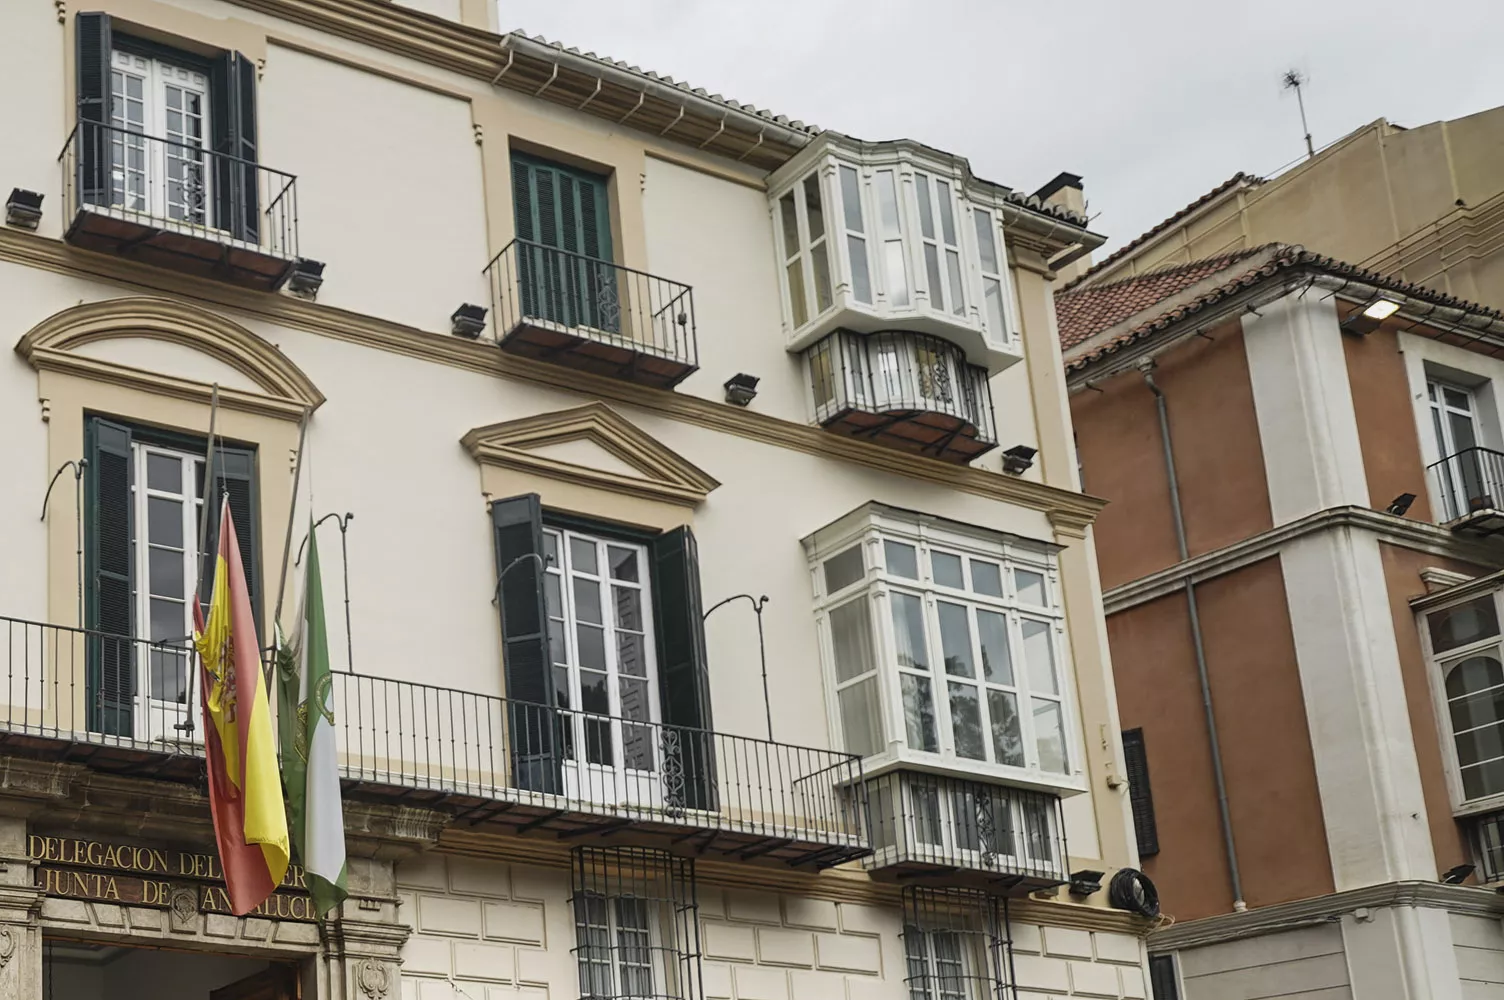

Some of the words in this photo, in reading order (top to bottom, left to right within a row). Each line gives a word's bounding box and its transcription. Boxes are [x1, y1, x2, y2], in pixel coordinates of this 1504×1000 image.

[29, 834, 167, 873] DELEGACION
[180, 852, 221, 879] DEL
[45, 869, 120, 900] JUNTA
[142, 880, 171, 906] DE
[201, 888, 325, 920] ANLUCI
